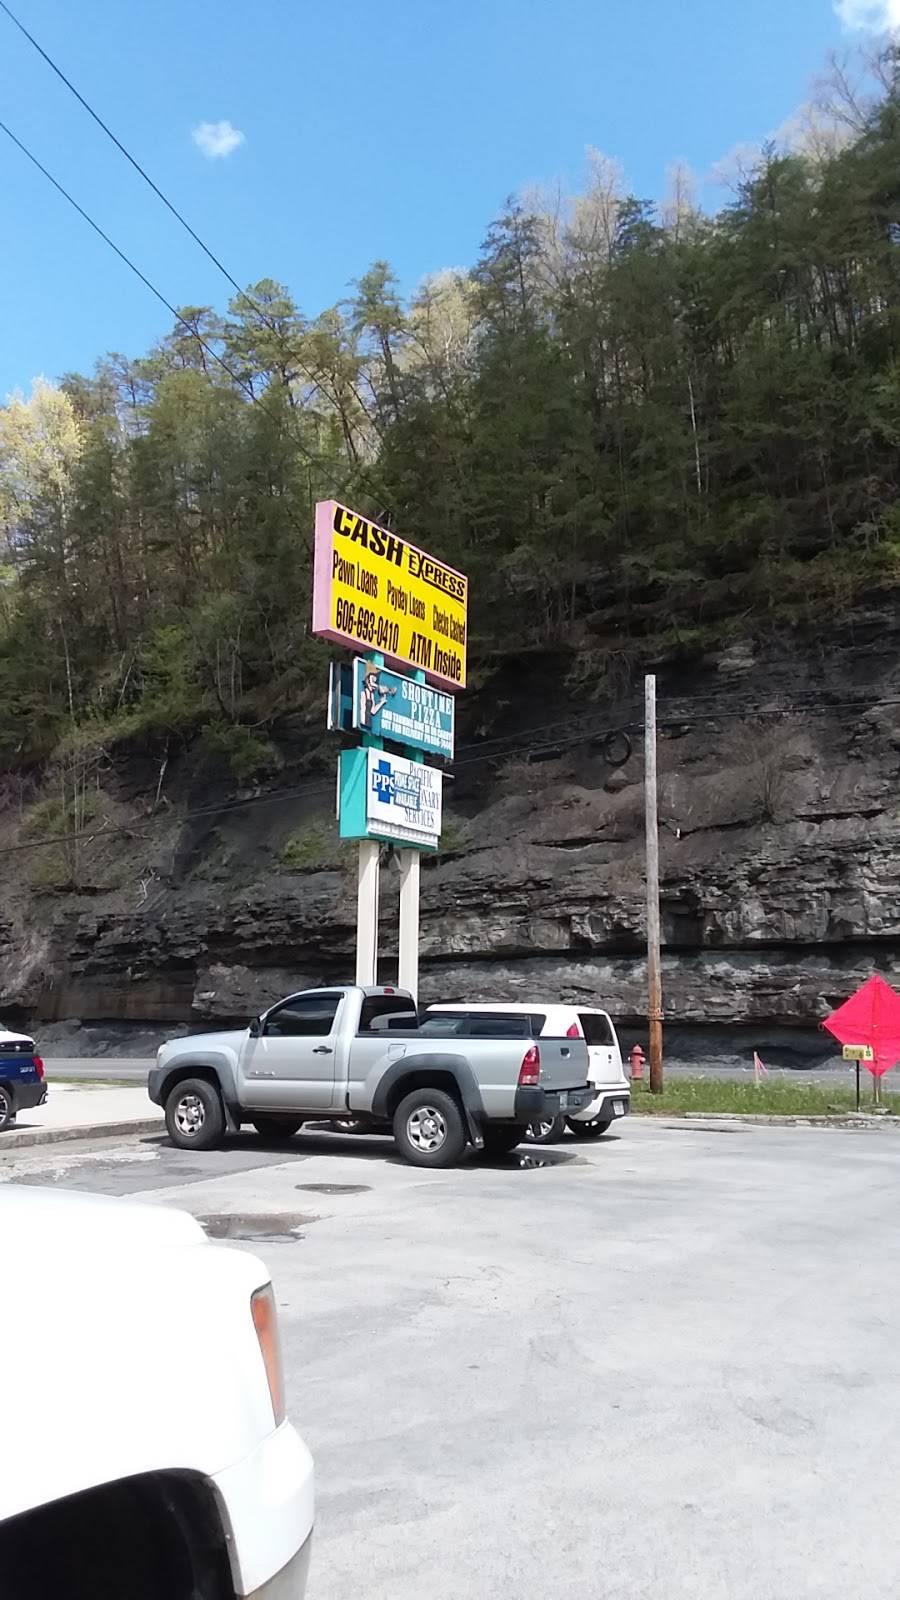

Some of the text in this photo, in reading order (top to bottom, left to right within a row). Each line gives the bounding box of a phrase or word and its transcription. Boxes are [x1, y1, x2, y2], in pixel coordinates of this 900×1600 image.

[332, 549, 356, 588] Pawn
[356, 562, 378, 599] Loans
[387, 579, 408, 616] Payday
[409, 591, 426, 621] Loans
[333, 506, 465, 598] CASH EXPRESS
[336, 597, 461, 681] 606-693-0410 ATM Inside
[401, 680, 452, 715] SHOWTIME
[411, 701, 442, 729] PIZZA
